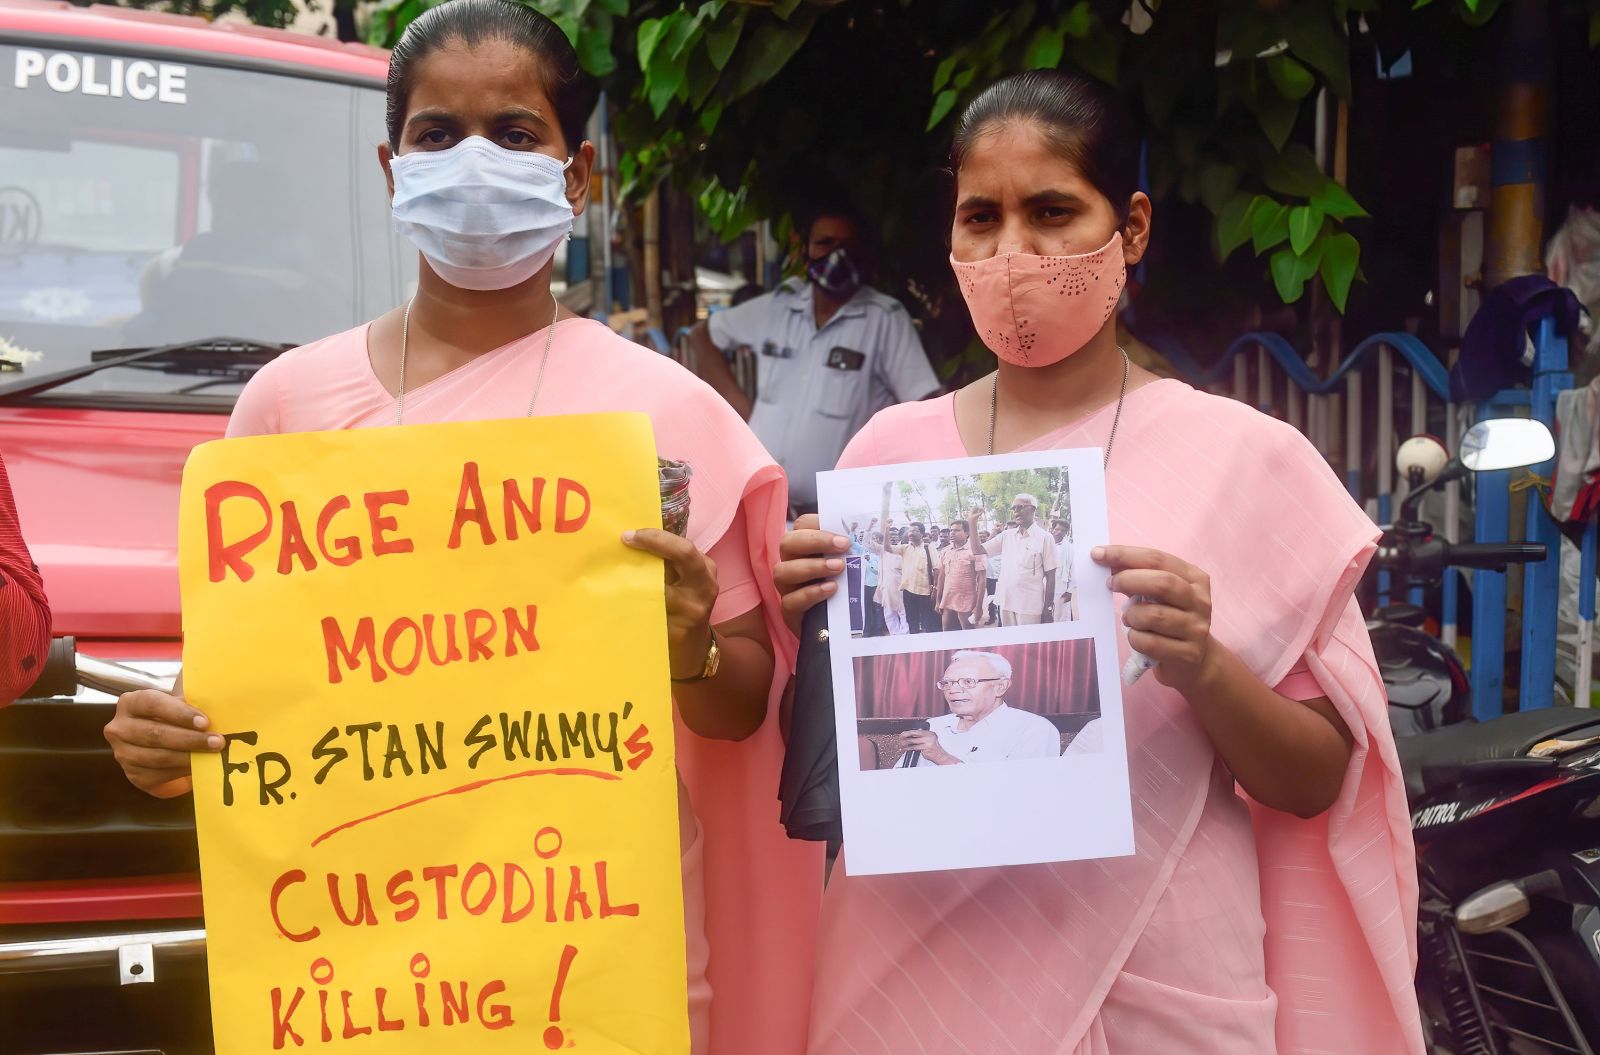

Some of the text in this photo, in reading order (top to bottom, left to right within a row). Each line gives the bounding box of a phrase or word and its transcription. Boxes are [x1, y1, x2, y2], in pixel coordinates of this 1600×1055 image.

[14, 50, 187, 104] POLICE
[204, 462, 591, 583] RAGE AND
[321, 605, 540, 685] MOURN
[220, 731, 297, 807] FR.
[312, 721, 448, 785] STAN
[1416, 801, 1460, 829] PATROL
